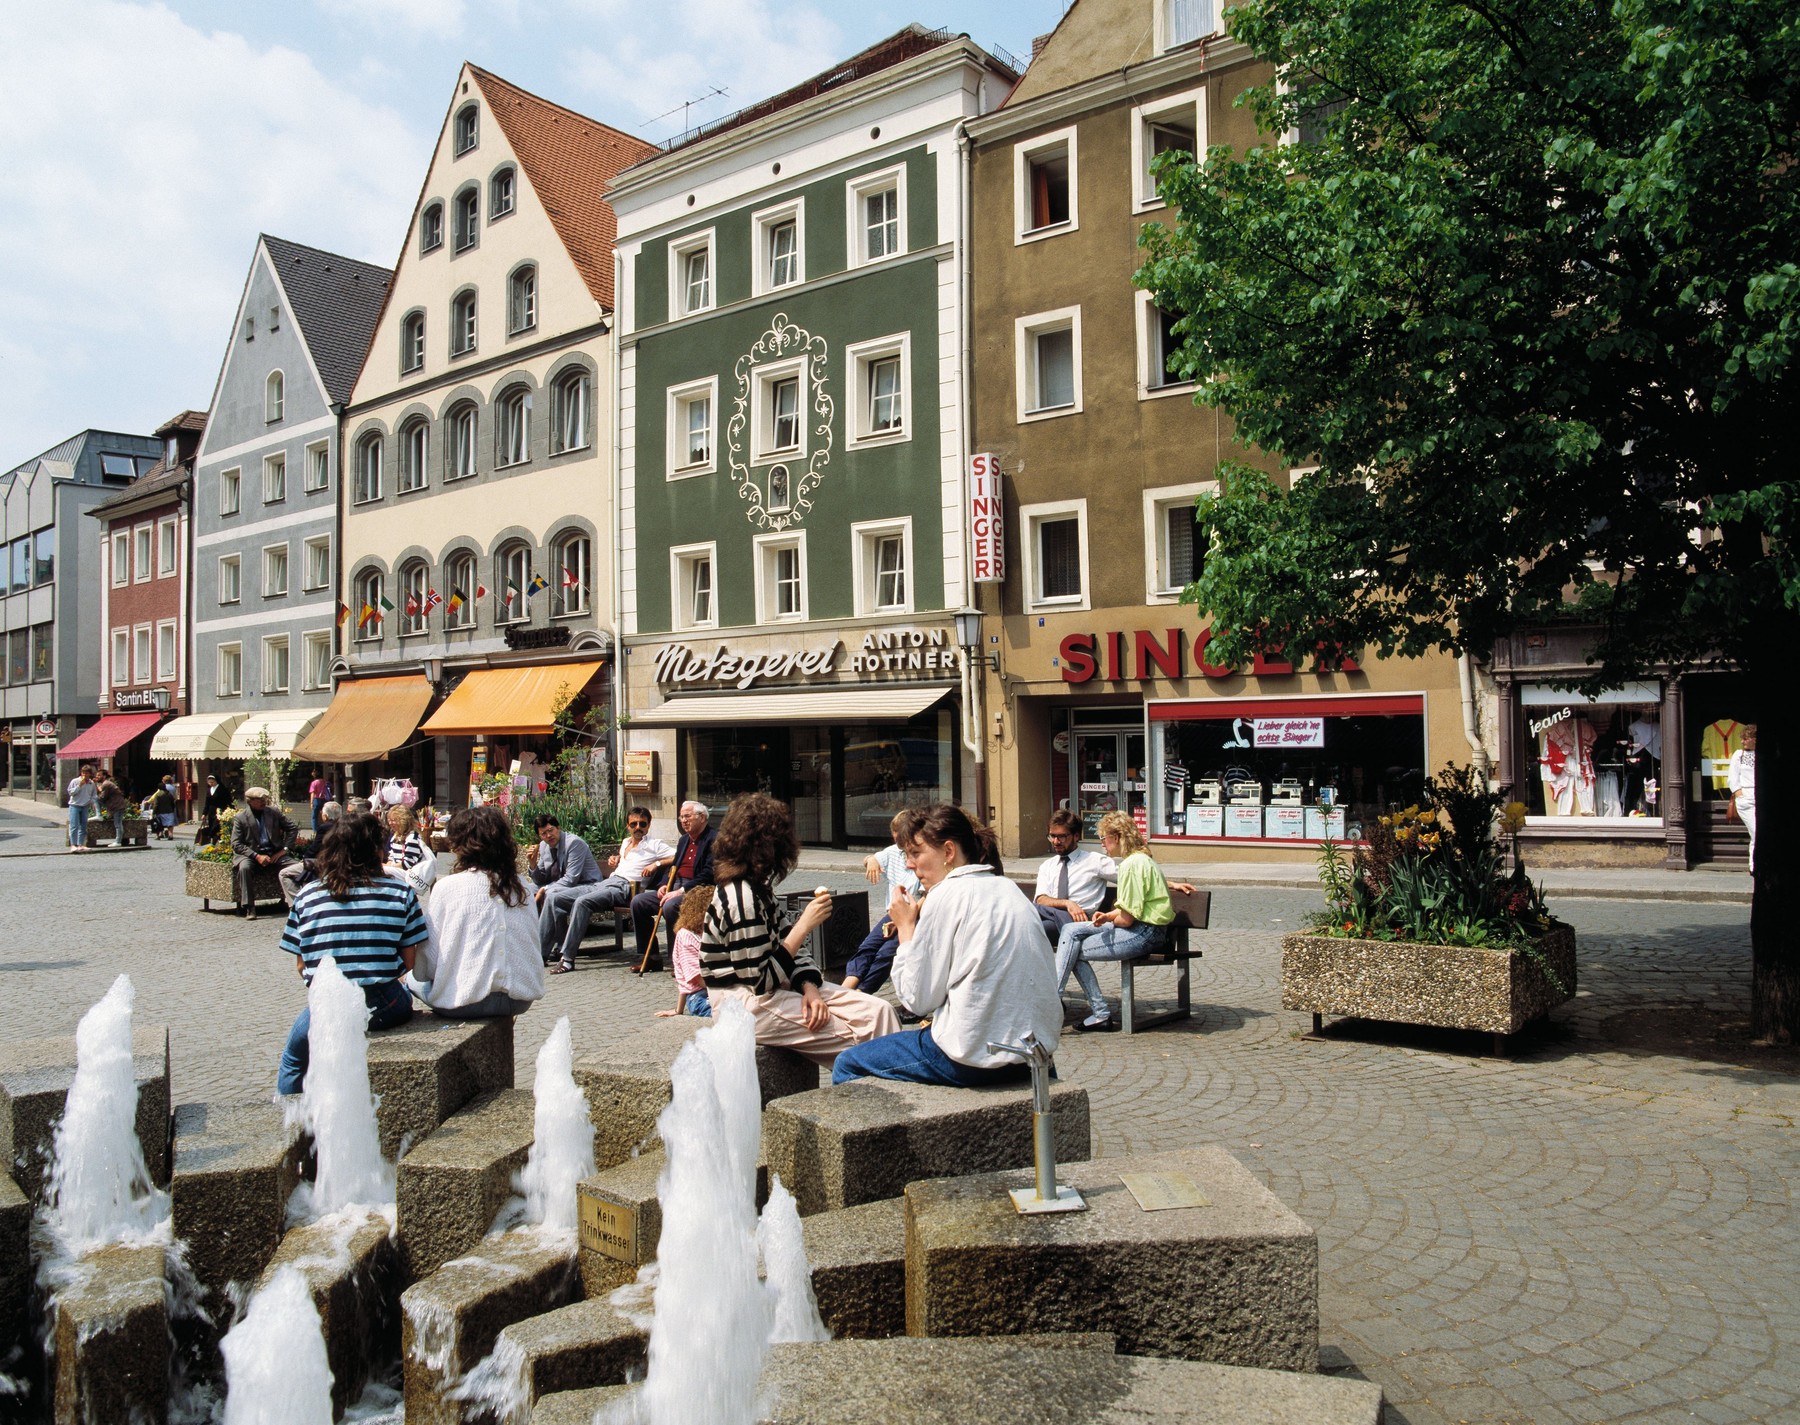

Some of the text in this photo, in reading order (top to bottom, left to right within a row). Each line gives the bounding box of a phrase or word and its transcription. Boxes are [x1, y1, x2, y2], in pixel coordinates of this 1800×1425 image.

[972, 456, 990, 578] SINGER
[991, 456, 1003, 578] SINGER
[862, 629, 943, 650] ANTON
[653, 638, 842, 690] Metzgerei
[851, 651, 954, 672] HOTTNER
[116, 691, 142, 707] Santin
[1257, 721, 1284, 731] Lieber
[1284, 720, 1308, 733] gleich
[1529, 706, 1571, 739] jeans
[1257, 732, 1280, 743] echte
[1282, 732, 1312, 745] Singer
[597, 1206, 616, 1226] Kein
[582, 1219, 630, 1250] Trinkwasser
